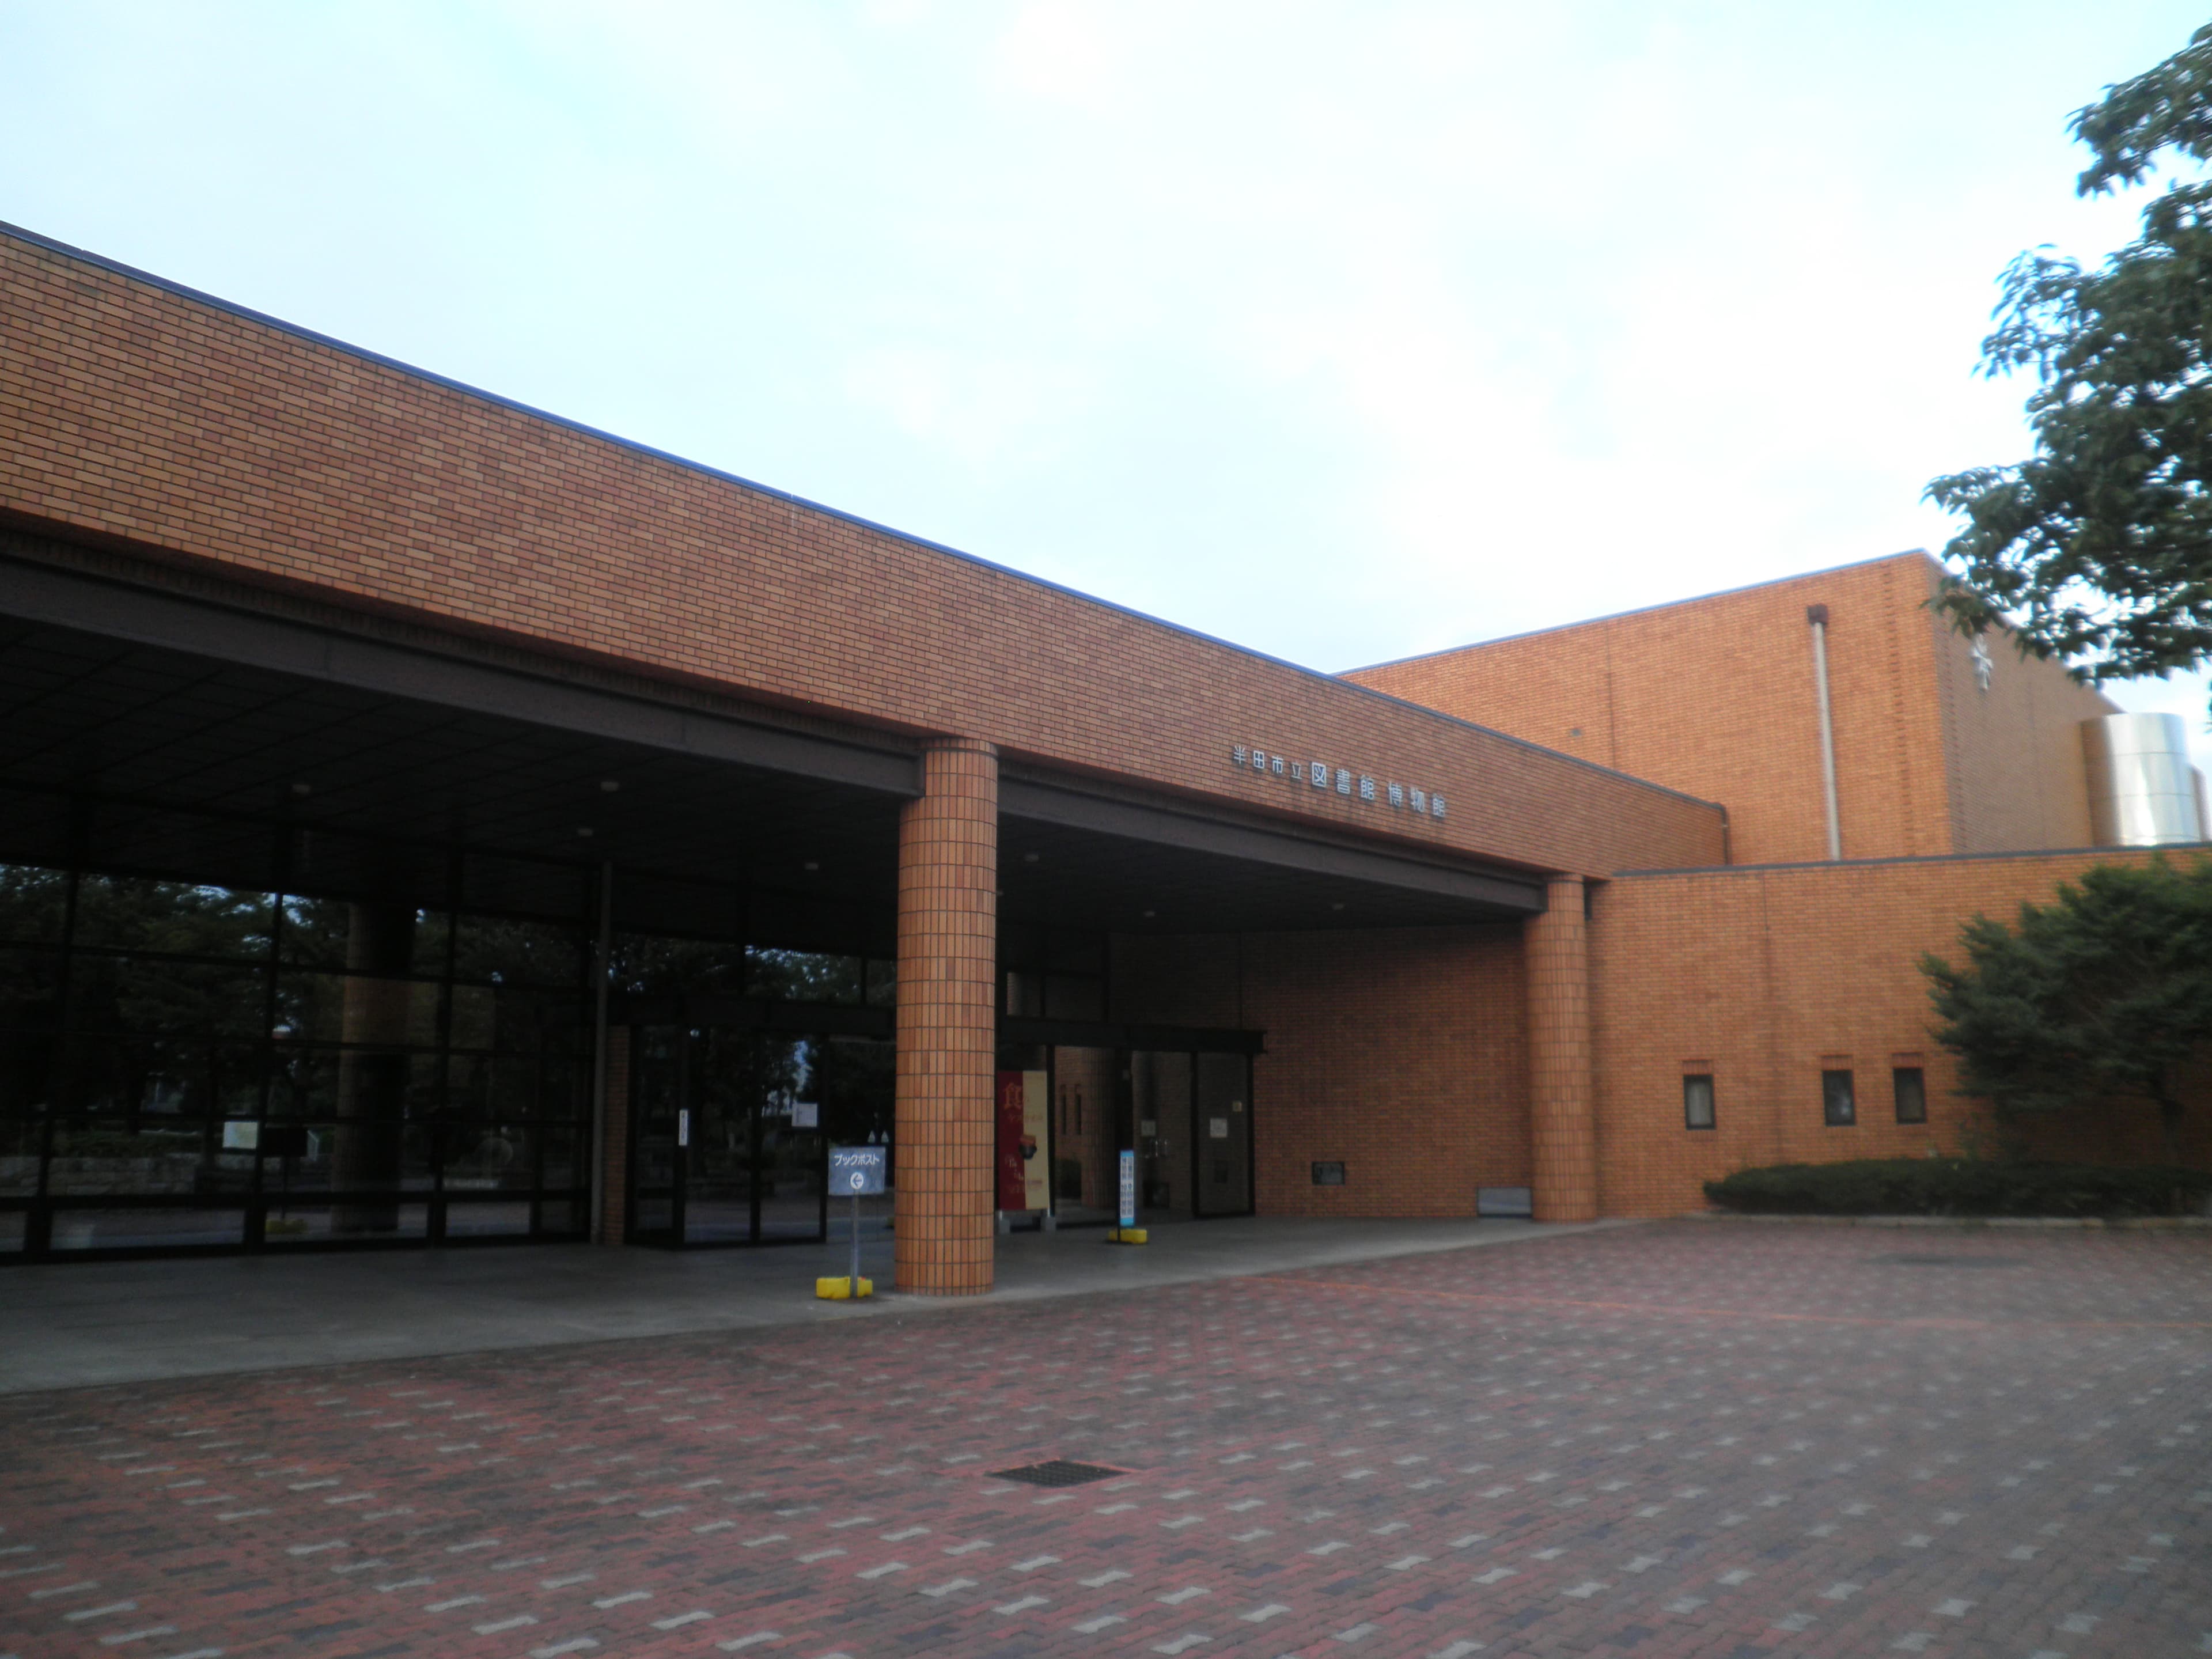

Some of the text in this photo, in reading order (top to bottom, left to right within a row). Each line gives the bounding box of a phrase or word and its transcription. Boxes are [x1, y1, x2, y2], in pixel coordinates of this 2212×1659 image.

[1233, 745, 1374, 800] 半田市立図書館
